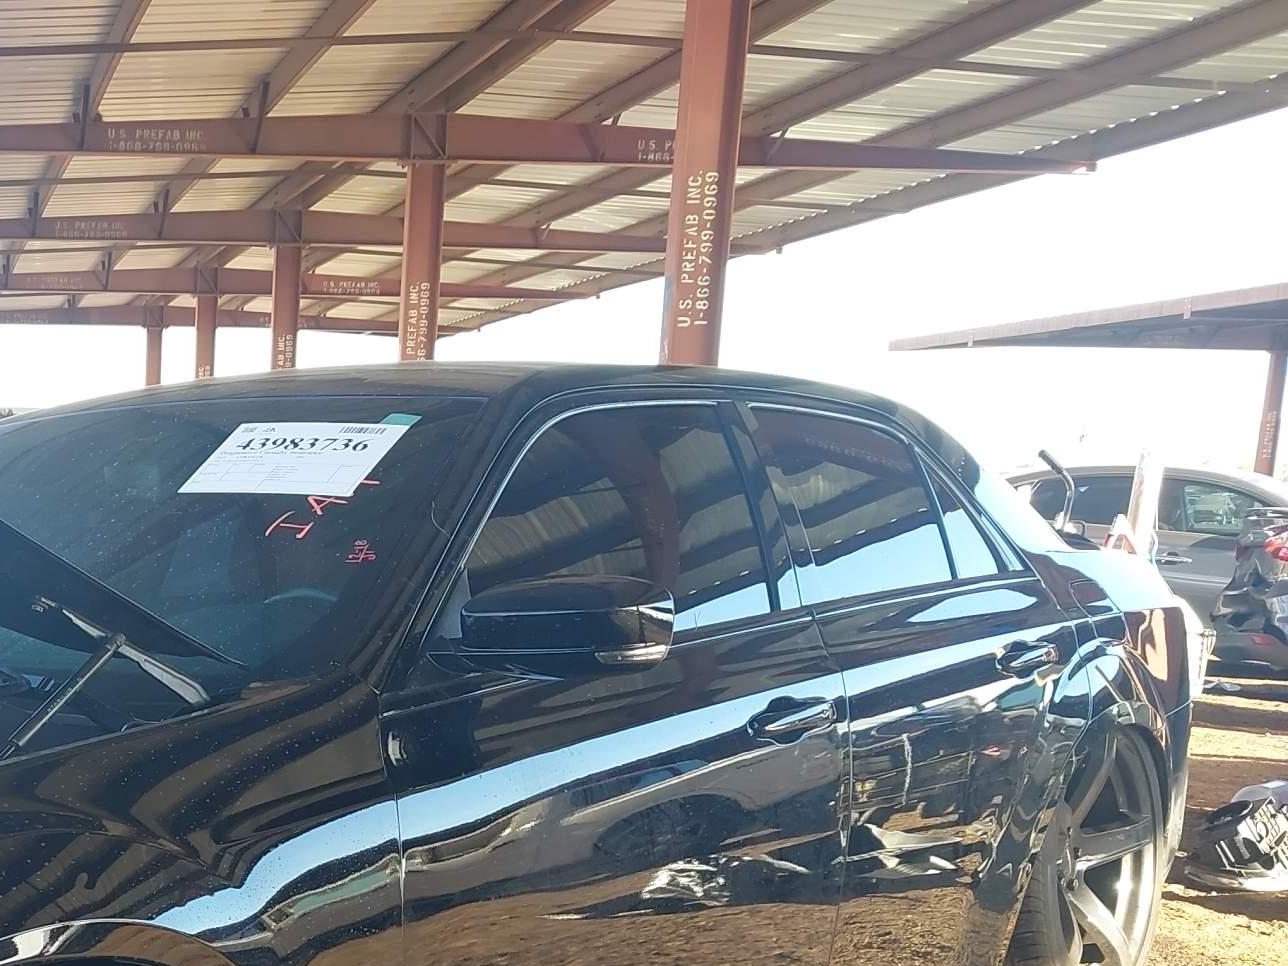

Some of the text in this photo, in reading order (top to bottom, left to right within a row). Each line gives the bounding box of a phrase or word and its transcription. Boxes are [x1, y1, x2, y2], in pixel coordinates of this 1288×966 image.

[135, 128, 181, 141] PREFAB
[677, 169, 703, 327] U.S. PREFAB INC.
[694, 171, 720, 326] 1-866-799-0969
[406, 280, 420, 355] PREFAB INC.
[236, 437, 374, 452] 43983736
